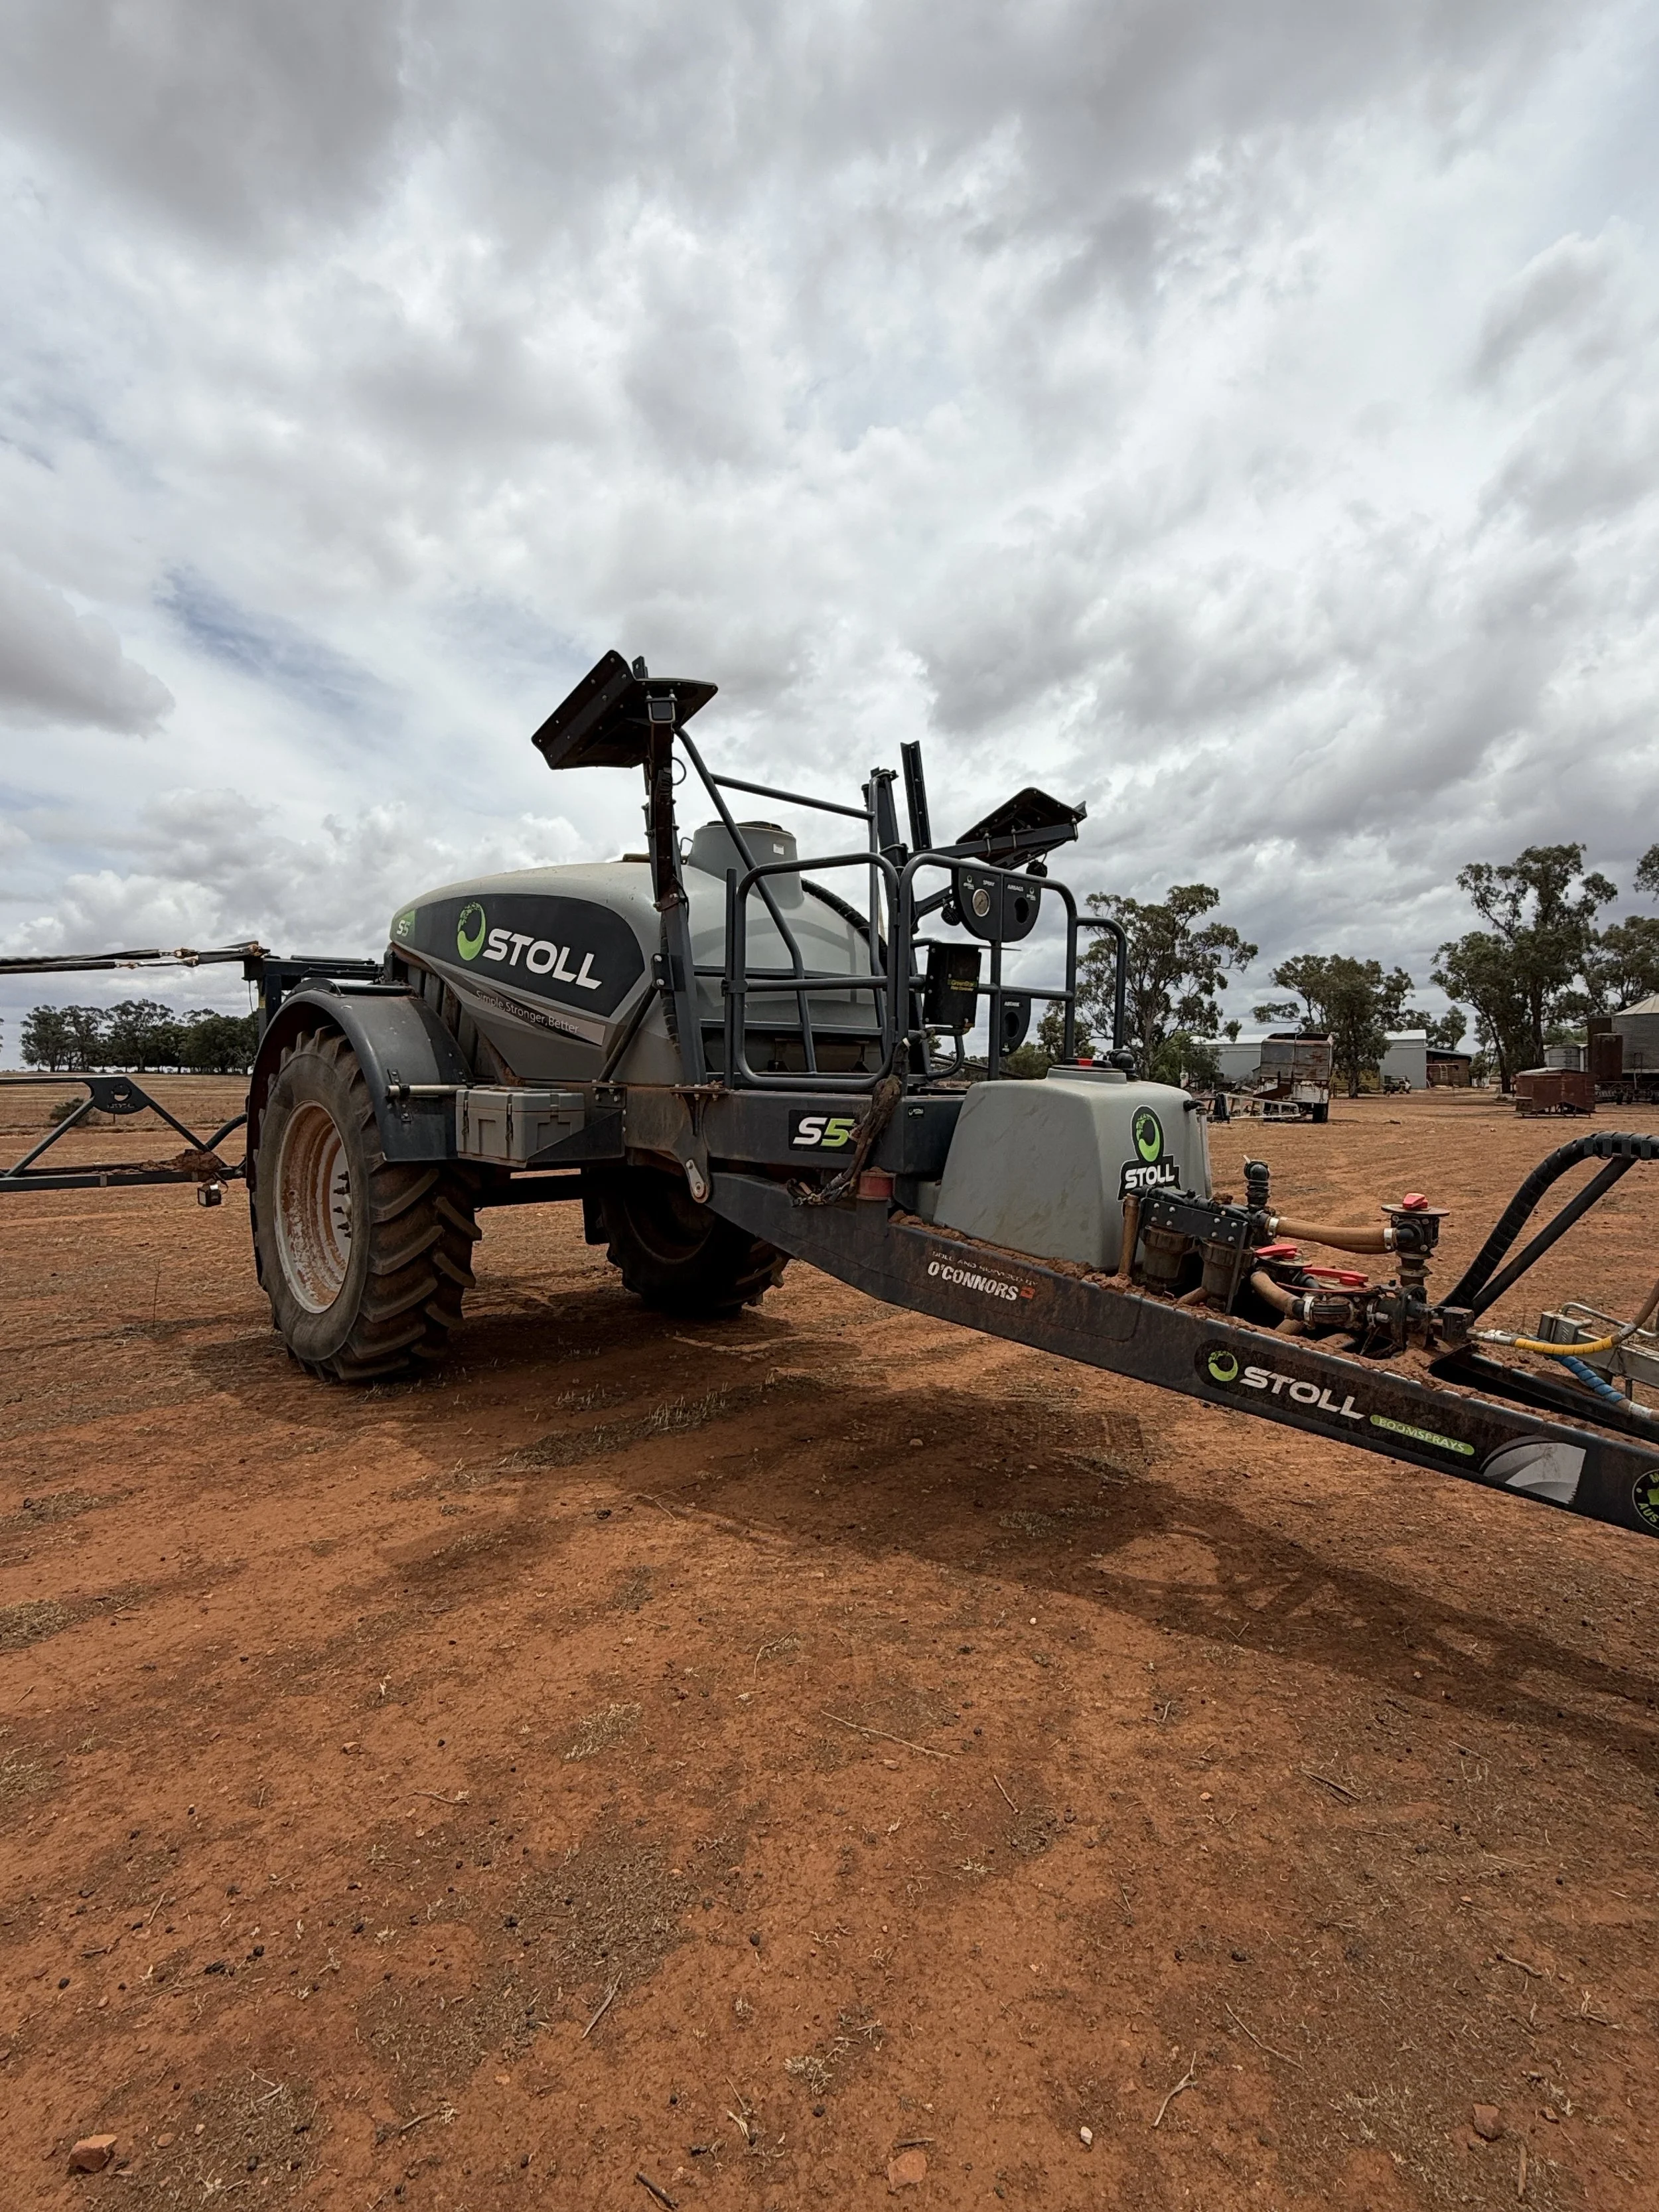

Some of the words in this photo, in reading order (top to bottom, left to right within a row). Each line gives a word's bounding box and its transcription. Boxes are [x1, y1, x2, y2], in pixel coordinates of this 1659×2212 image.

[396, 919, 411, 937] S5
[482, 928, 603, 990] STOLL
[792, 1116, 855, 1147] S5
[1124, 1163, 1175, 1189] STOLL
[927, 1261, 1019, 1301] O'CONNORS
[1239, 1366, 1366, 1420] STOLL
[1379, 1416, 1465, 1453] BOOMSPRAYS
